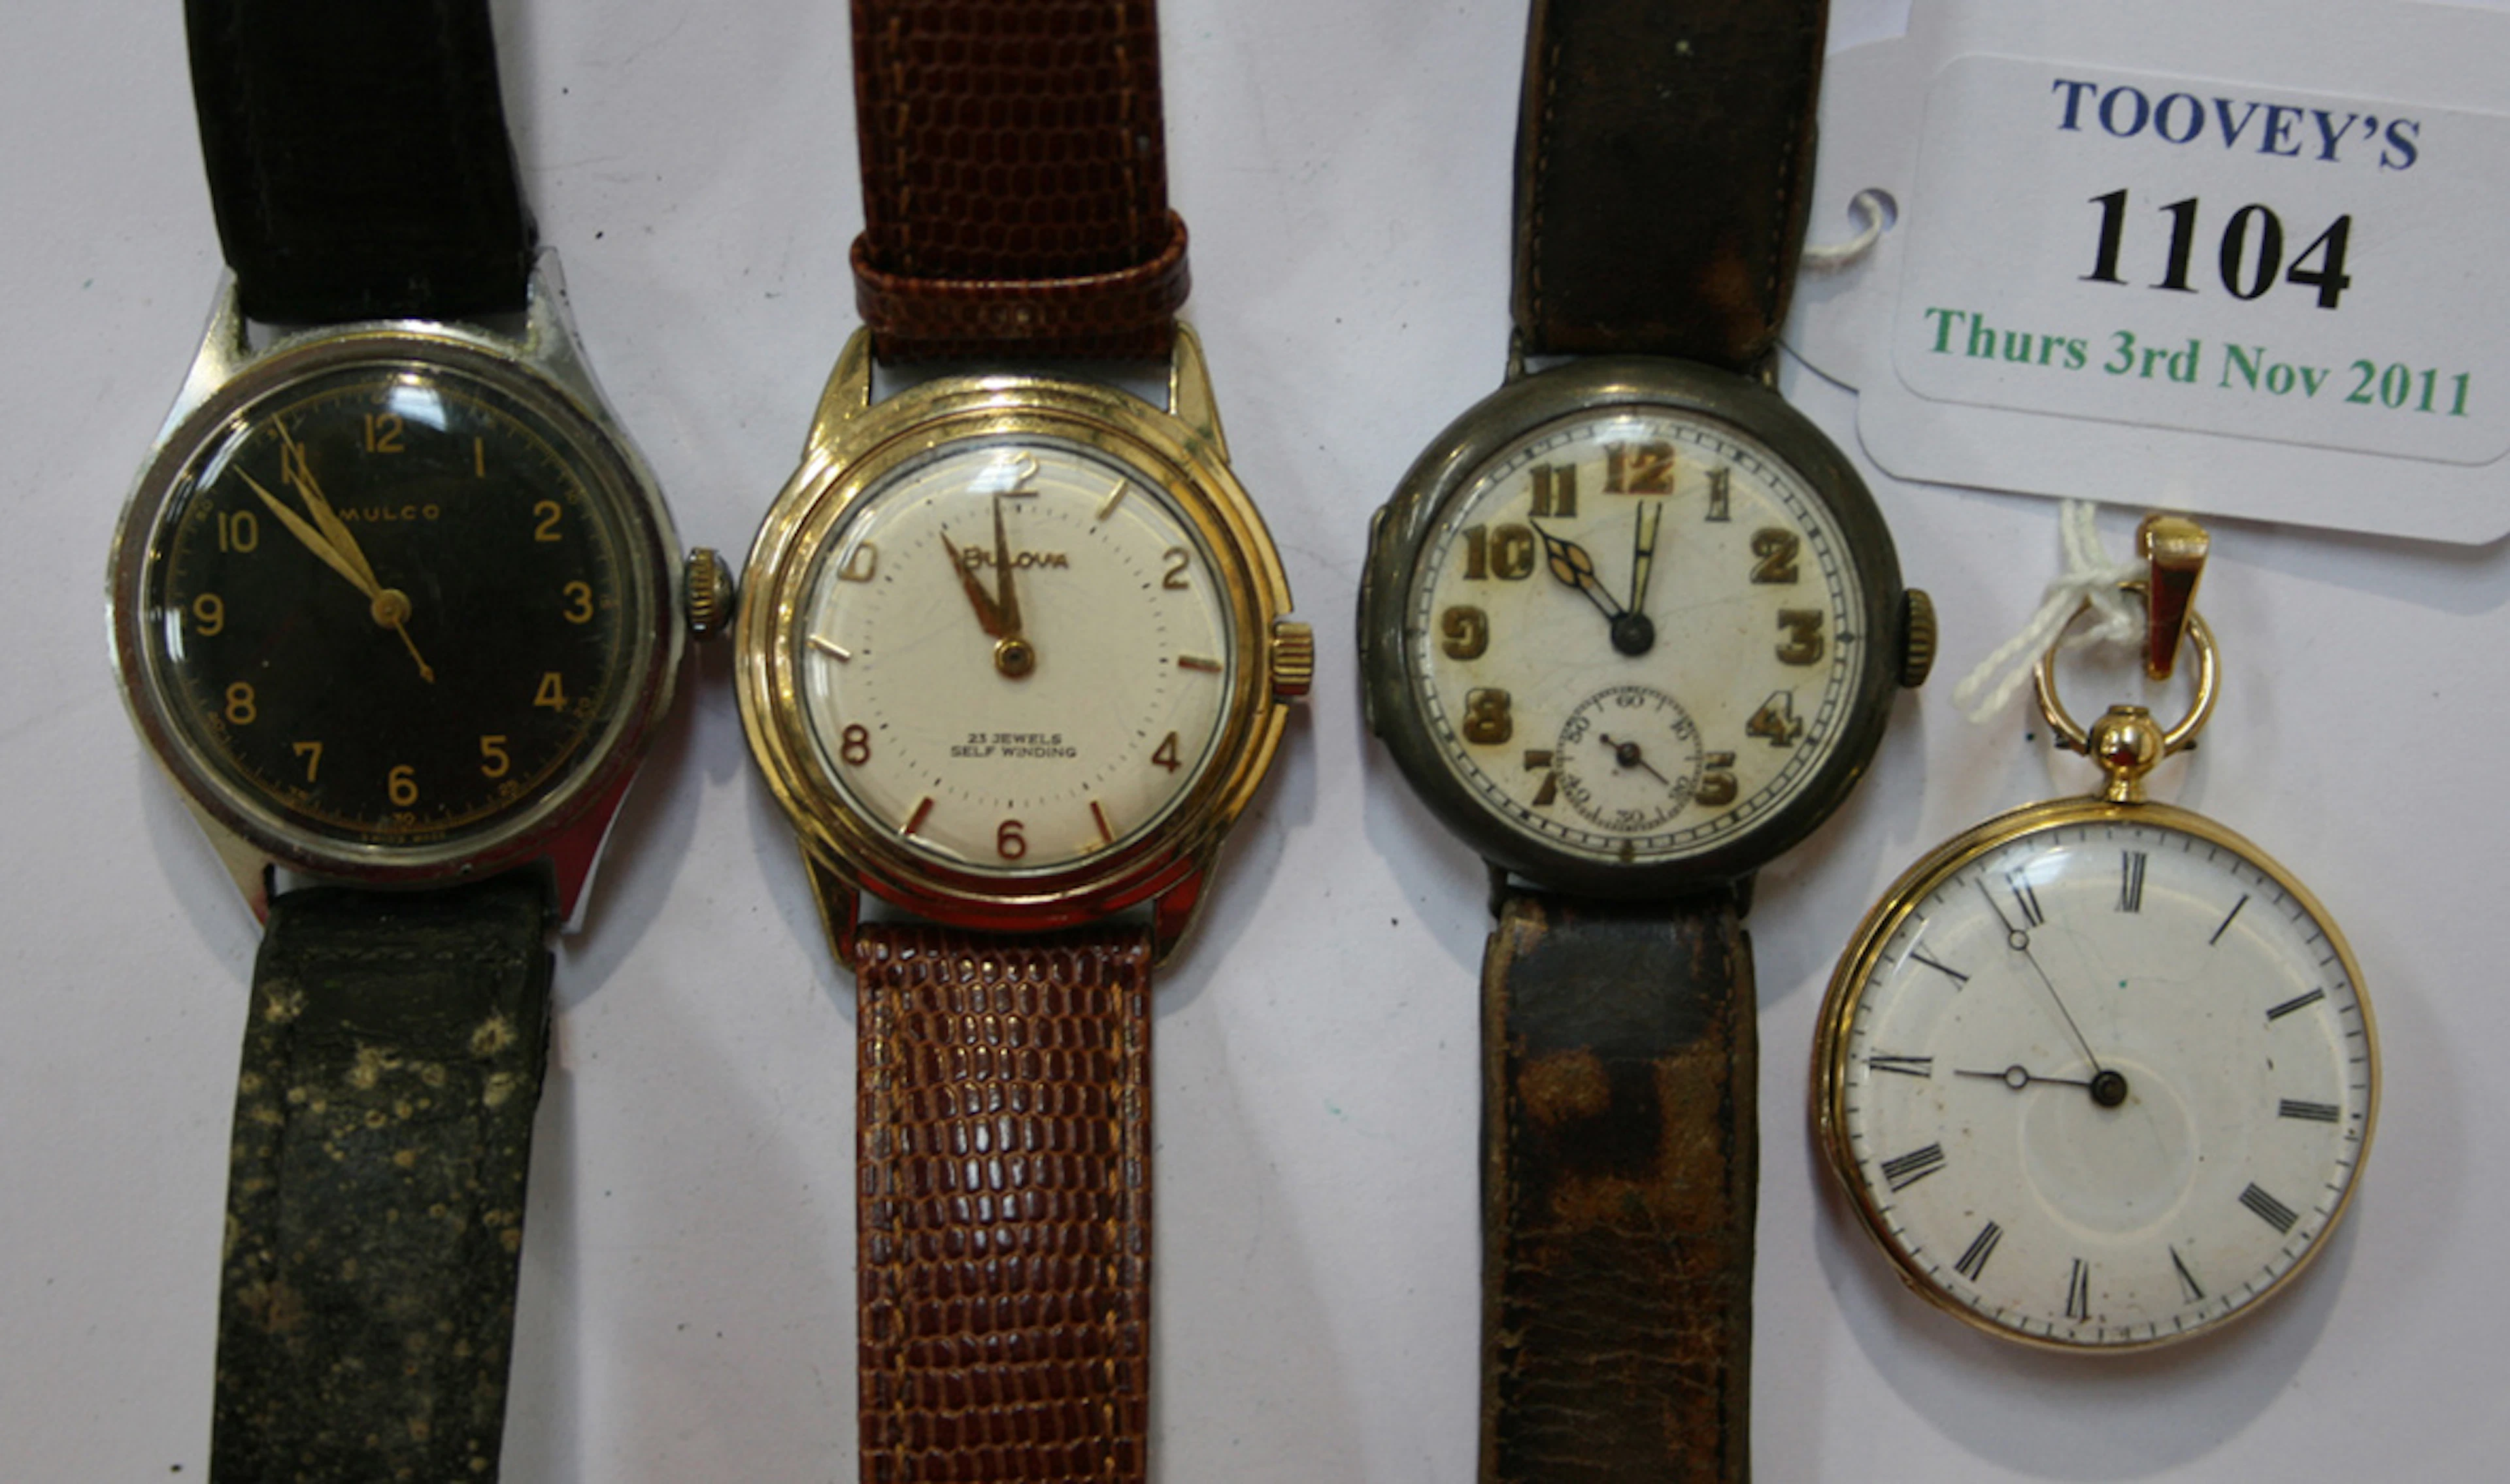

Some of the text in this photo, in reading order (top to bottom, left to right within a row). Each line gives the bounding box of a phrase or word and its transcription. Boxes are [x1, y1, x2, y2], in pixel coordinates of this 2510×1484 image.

[2052, 78, 2420, 171] TOOVEY'S
[2077, 188, 2352, 310] 1104
[1925, 306, 2471, 418] Thurs 3rd Nov 2011
[364, 412, 406, 453] 12
[474, 436, 486, 478] 1
[1603, 439, 1675, 495] 12
[339, 503, 441, 522] MULCO
[1528, 462, 1578, 518] 11
[1705, 466, 1732, 522] 1
[218, 510, 259, 553] 10
[533, 500, 563, 543] 2
[1162, 546, 1190, 591] 2
[1461, 523, 1535, 580] 10
[1749, 525, 1801, 585] 2
[193, 592, 225, 637] 9
[563, 580, 594, 625] 3
[1441, 604, 1490, 662] 9
[1775, 608, 1825, 667] 3
[226, 680, 257, 726] 8
[532, 671, 568, 713] 4
[1462, 687, 1514, 746] 8
[1745, 689, 1803, 748] 4
[292, 740, 323, 783] 7
[479, 734, 510, 778] 5
[841, 723, 871, 767] 8
[950, 745, 1077, 759] SELF WINDING
[967, 733, 1062, 746] 23 JEWELS
[1151, 731, 1182, 774] 4
[388, 765, 419, 808] 6
[1524, 750, 1559, 807] 7
[1694, 750, 1739, 808] 5
[997, 819, 1027, 861] 6
